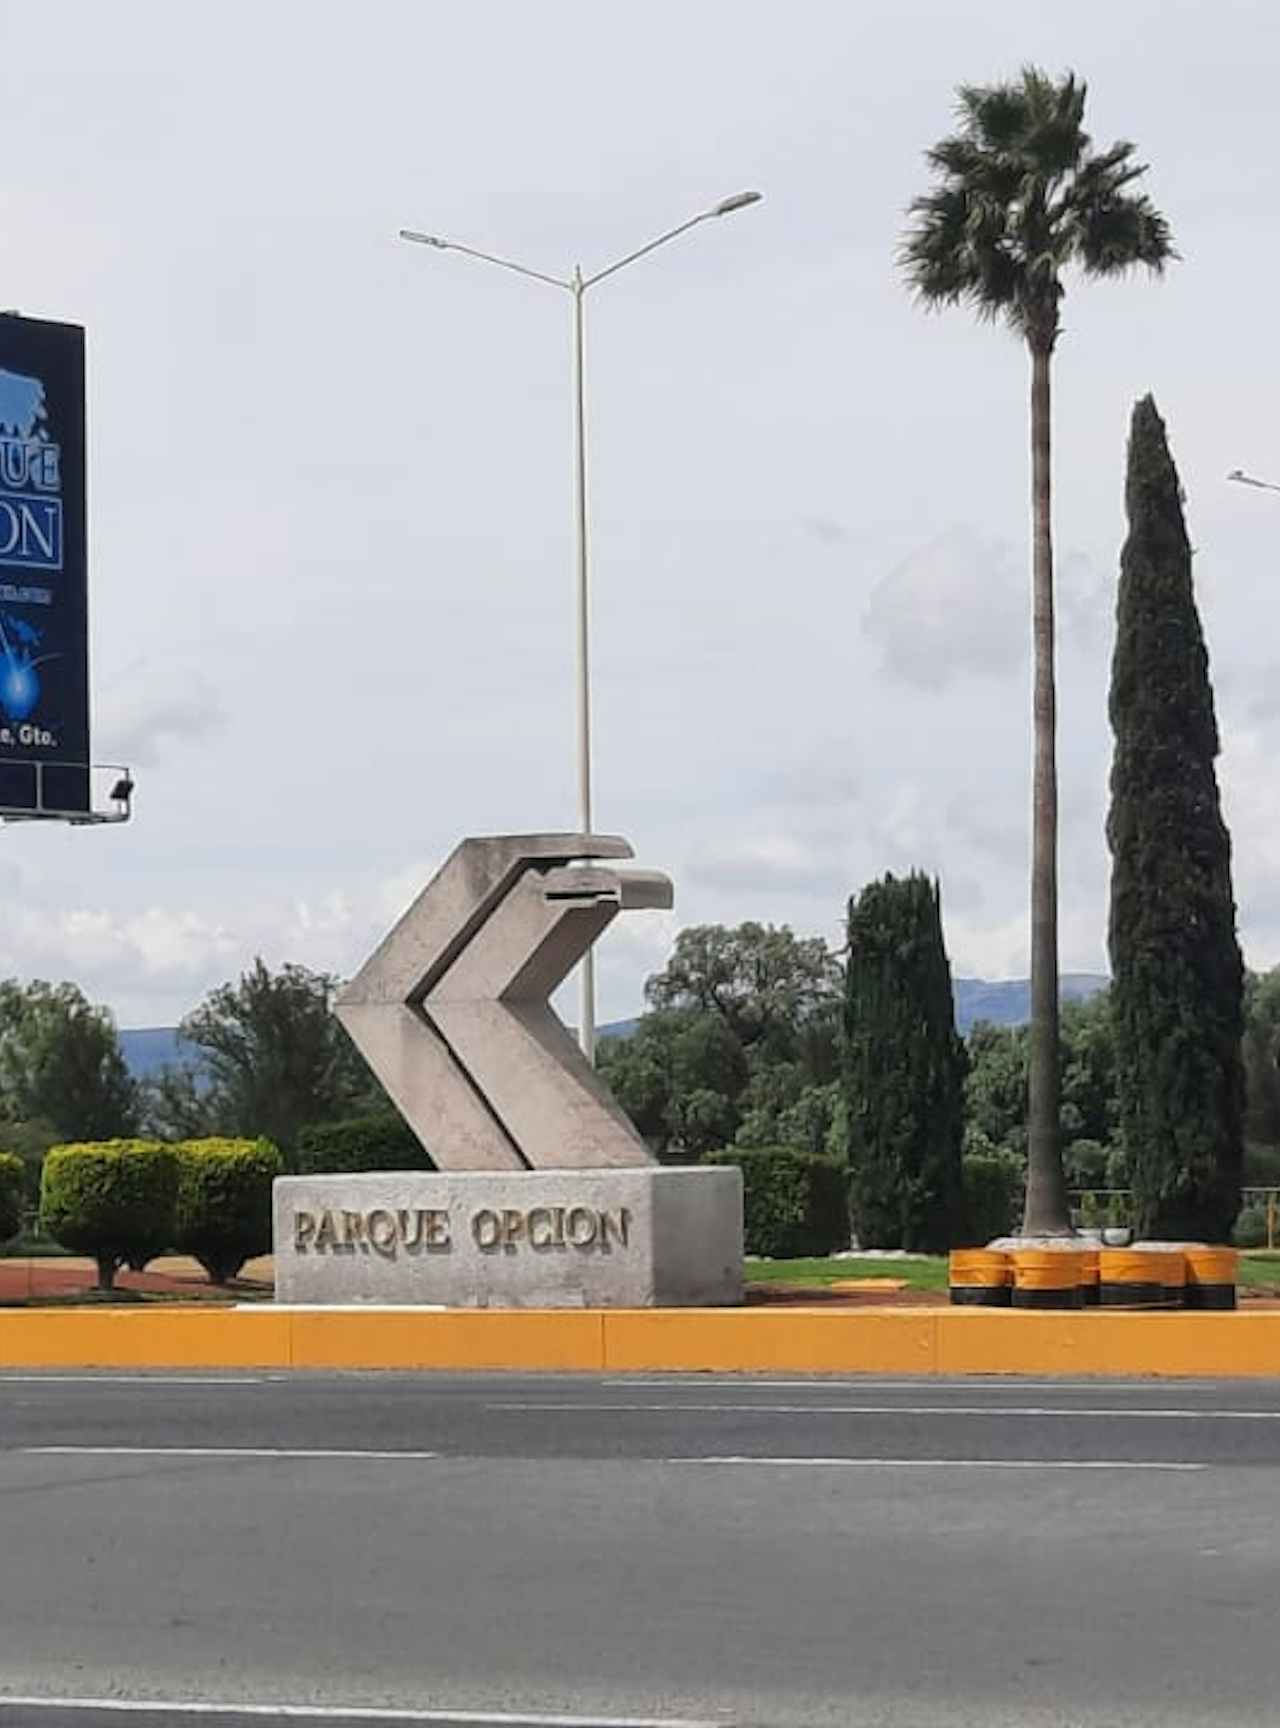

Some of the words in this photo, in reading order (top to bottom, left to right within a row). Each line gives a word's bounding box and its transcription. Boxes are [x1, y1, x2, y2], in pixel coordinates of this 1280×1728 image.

[19, 724, 58, 747] Gto.
[294, 1208, 452, 1262] PARQUE
[472, 1206, 633, 1256] OPCION
